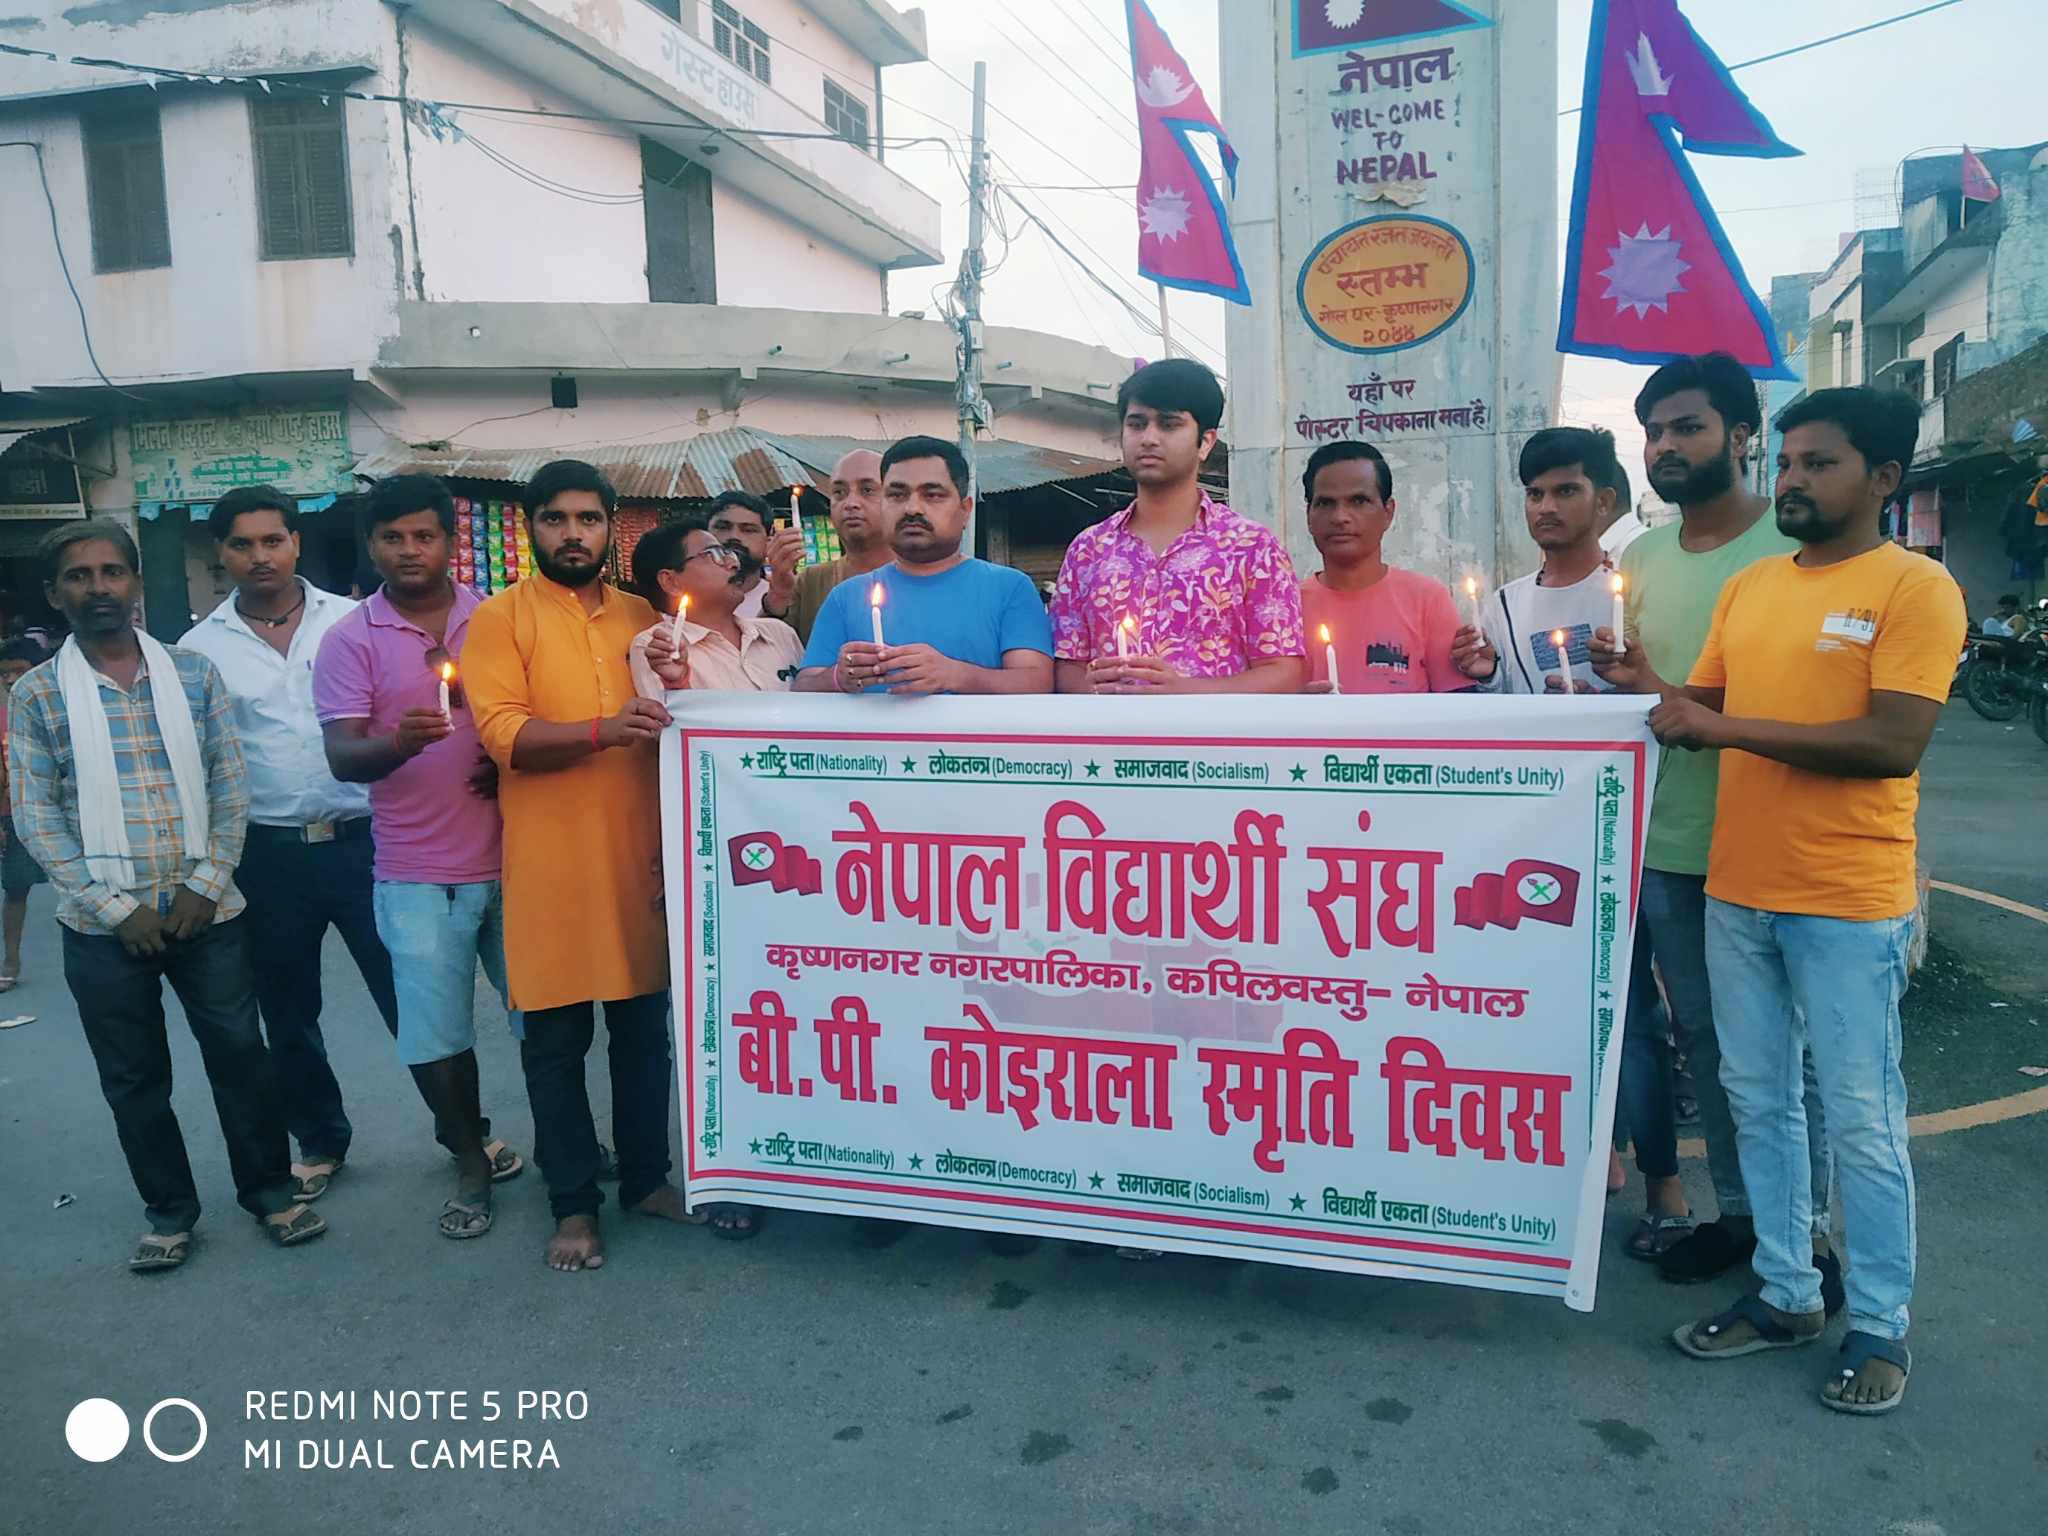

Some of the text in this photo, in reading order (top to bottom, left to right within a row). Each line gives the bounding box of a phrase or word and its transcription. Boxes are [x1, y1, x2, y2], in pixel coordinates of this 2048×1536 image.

[1337, 47, 1455, 93] नेपाल
[1372, 131, 1404, 151] TO
[1337, 151, 1438, 185] NEPAL
[1336, 262, 1430, 299] स्तम्भ
[1346, 371, 1416, 405] यहाँ पर
[1356, 408, 1437, 434] चिपकाना
[928, 748, 1073, 780] लोकतन्त्र (Democracy)
[1114, 759, 1270, 783] समाजवाद (Socialism)
[1323, 754, 1565, 791] विद्यार्थी एकता (Student's Unity)
[831, 801, 1444, 958] नेपाल विद्यार्थी संघ
[765, 943, 923, 981] कृष्णनगर
[928, 949, 1153, 994] नगरपालिका,
[1405, 972, 1530, 1018] नेपाल
[731, 990, 1572, 1173] बी.पी. कोइराला स्मृति दिवस
[935, 1149, 1078, 1190] लोकतन्त्र (Democracy)
[1117, 1173, 1271, 1210] समाजवाद (Socialism)
[1322, 1187, 1557, 1242] विद्यार्थी एकता (Student's Unity)
